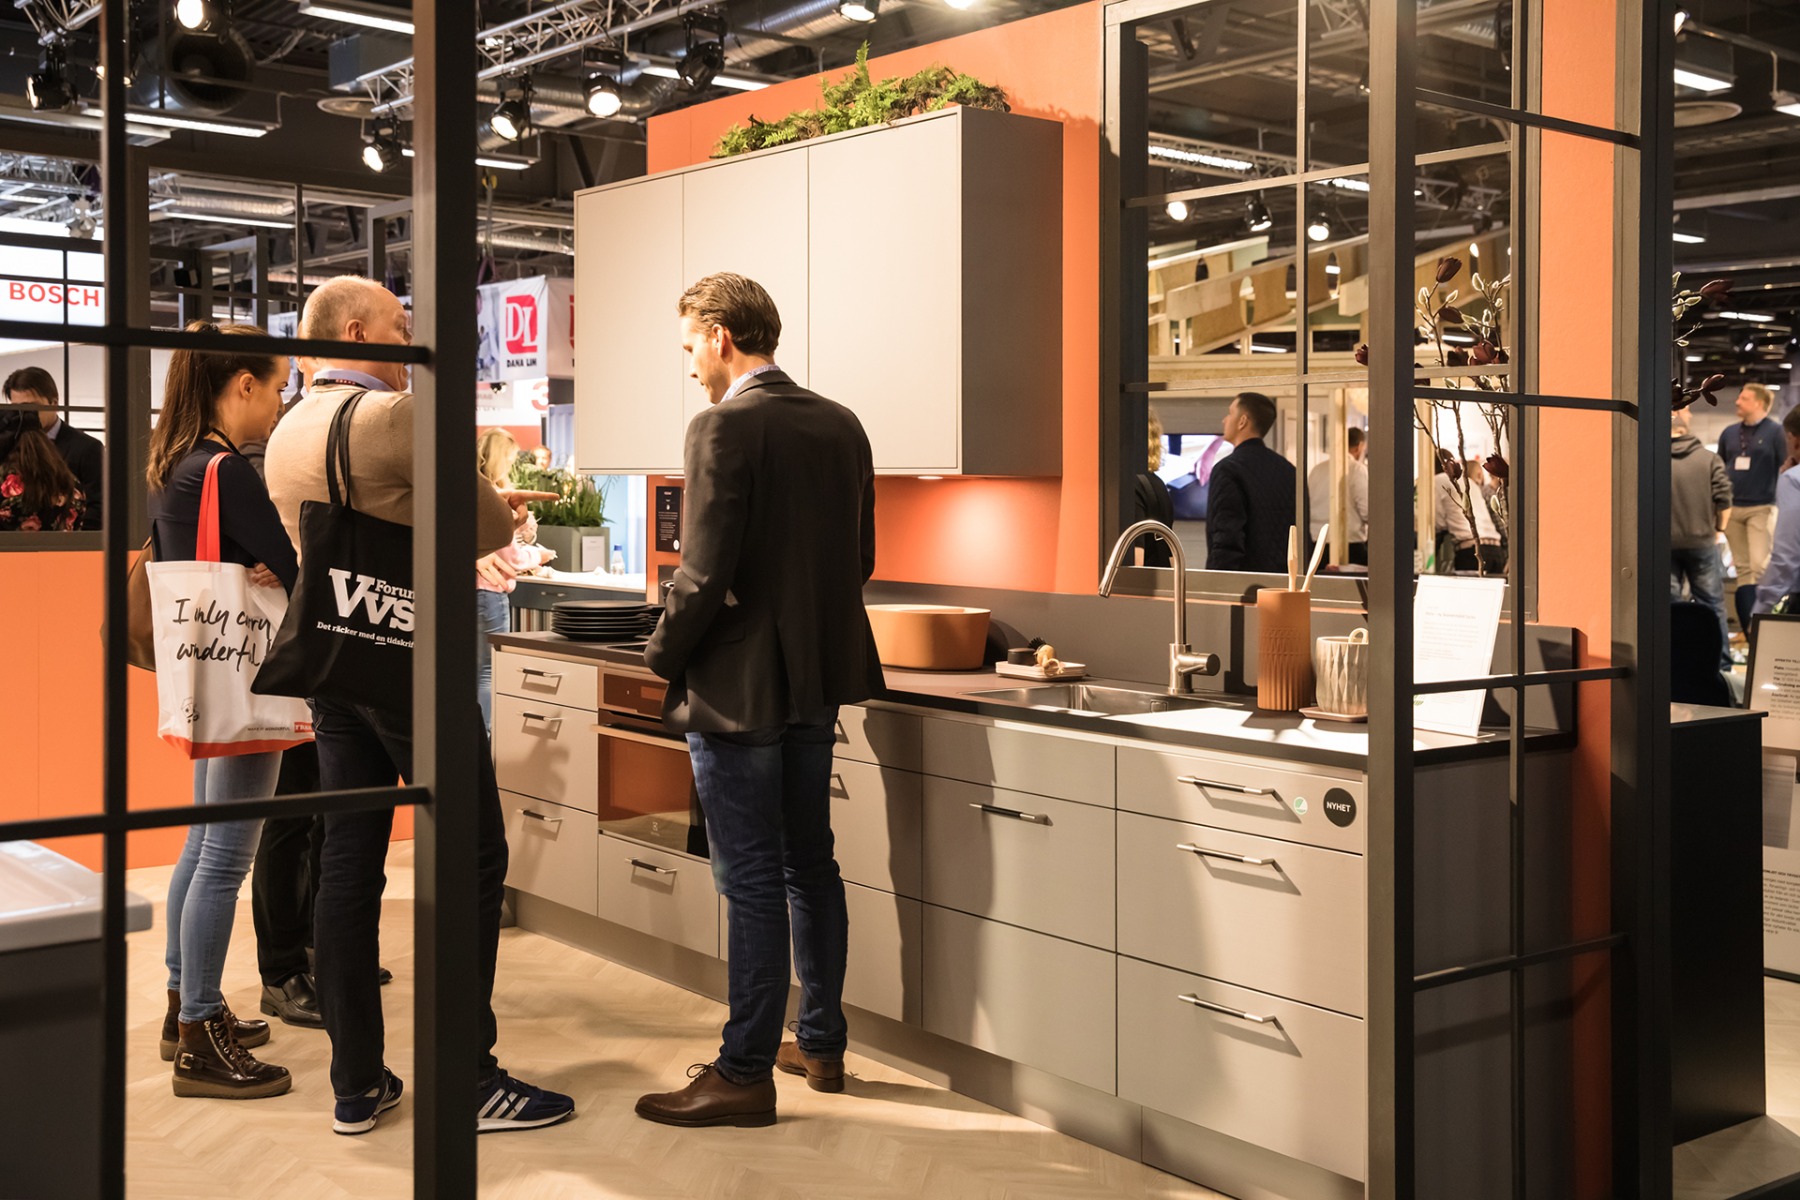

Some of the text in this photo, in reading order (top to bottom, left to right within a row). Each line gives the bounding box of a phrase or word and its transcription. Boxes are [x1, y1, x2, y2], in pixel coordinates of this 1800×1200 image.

[9, 282, 99, 307] BOSCH
[507, 359, 524, 368] DANA
[172, 598, 191, 624] I
[316, 621, 415, 649] Det räcker med en tidskrif
[1326, 801, 1351, 812] NYHET
